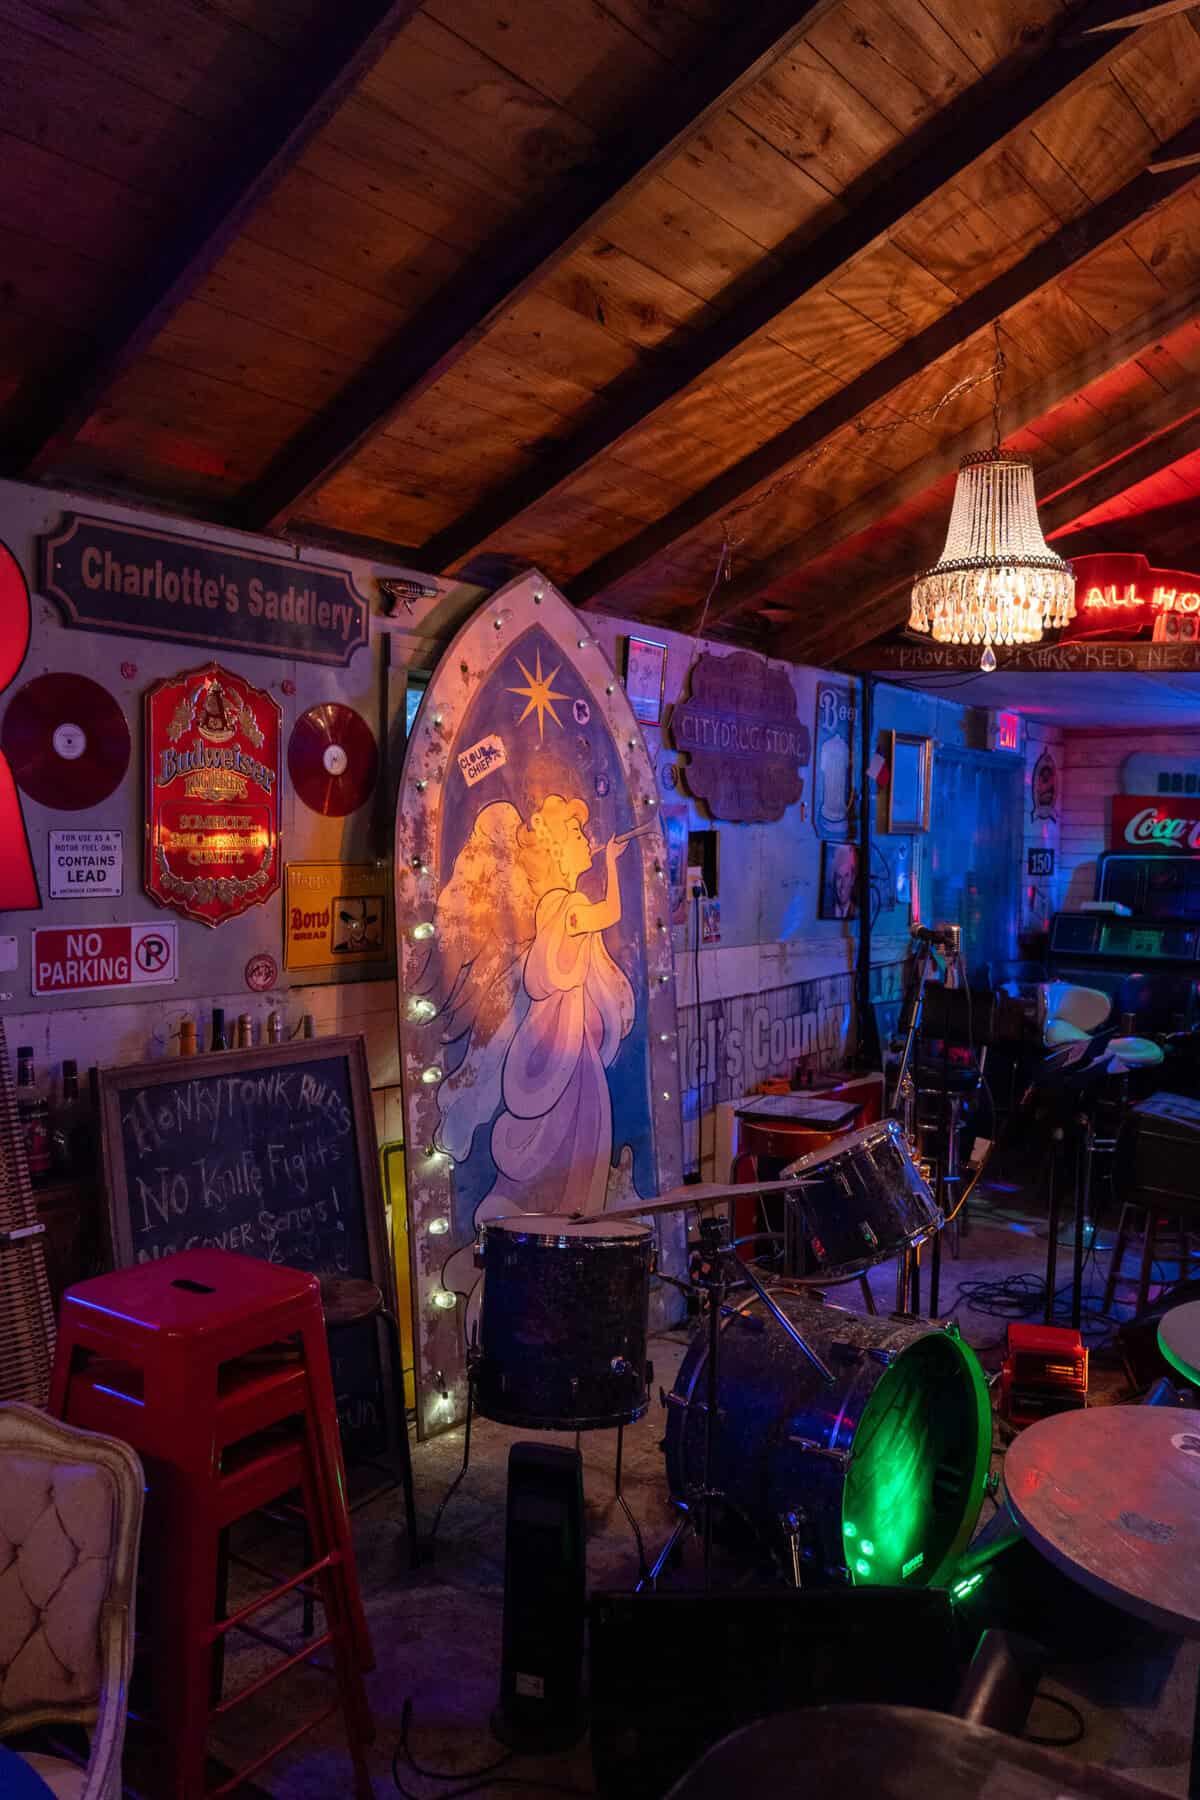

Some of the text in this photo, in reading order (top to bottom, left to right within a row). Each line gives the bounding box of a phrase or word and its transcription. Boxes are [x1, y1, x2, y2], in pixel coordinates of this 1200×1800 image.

[81, 546, 353, 641] Charlotte's Saddlery
[1085, 584, 1145, 608] ALL
[680, 714, 808, 759] CITY DRUG STORE
[1000, 713, 1018, 749] EXIT
[155, 738, 276, 795] Budweiser
[57, 855, 116, 867] CONTAINS
[67, 870, 107, 883] LEAD
[290, 906, 330, 931] Bond
[66, 933, 103, 958] NO
[293, 931, 327, 942] BREAD
[39, 956, 129, 986] PARKING
